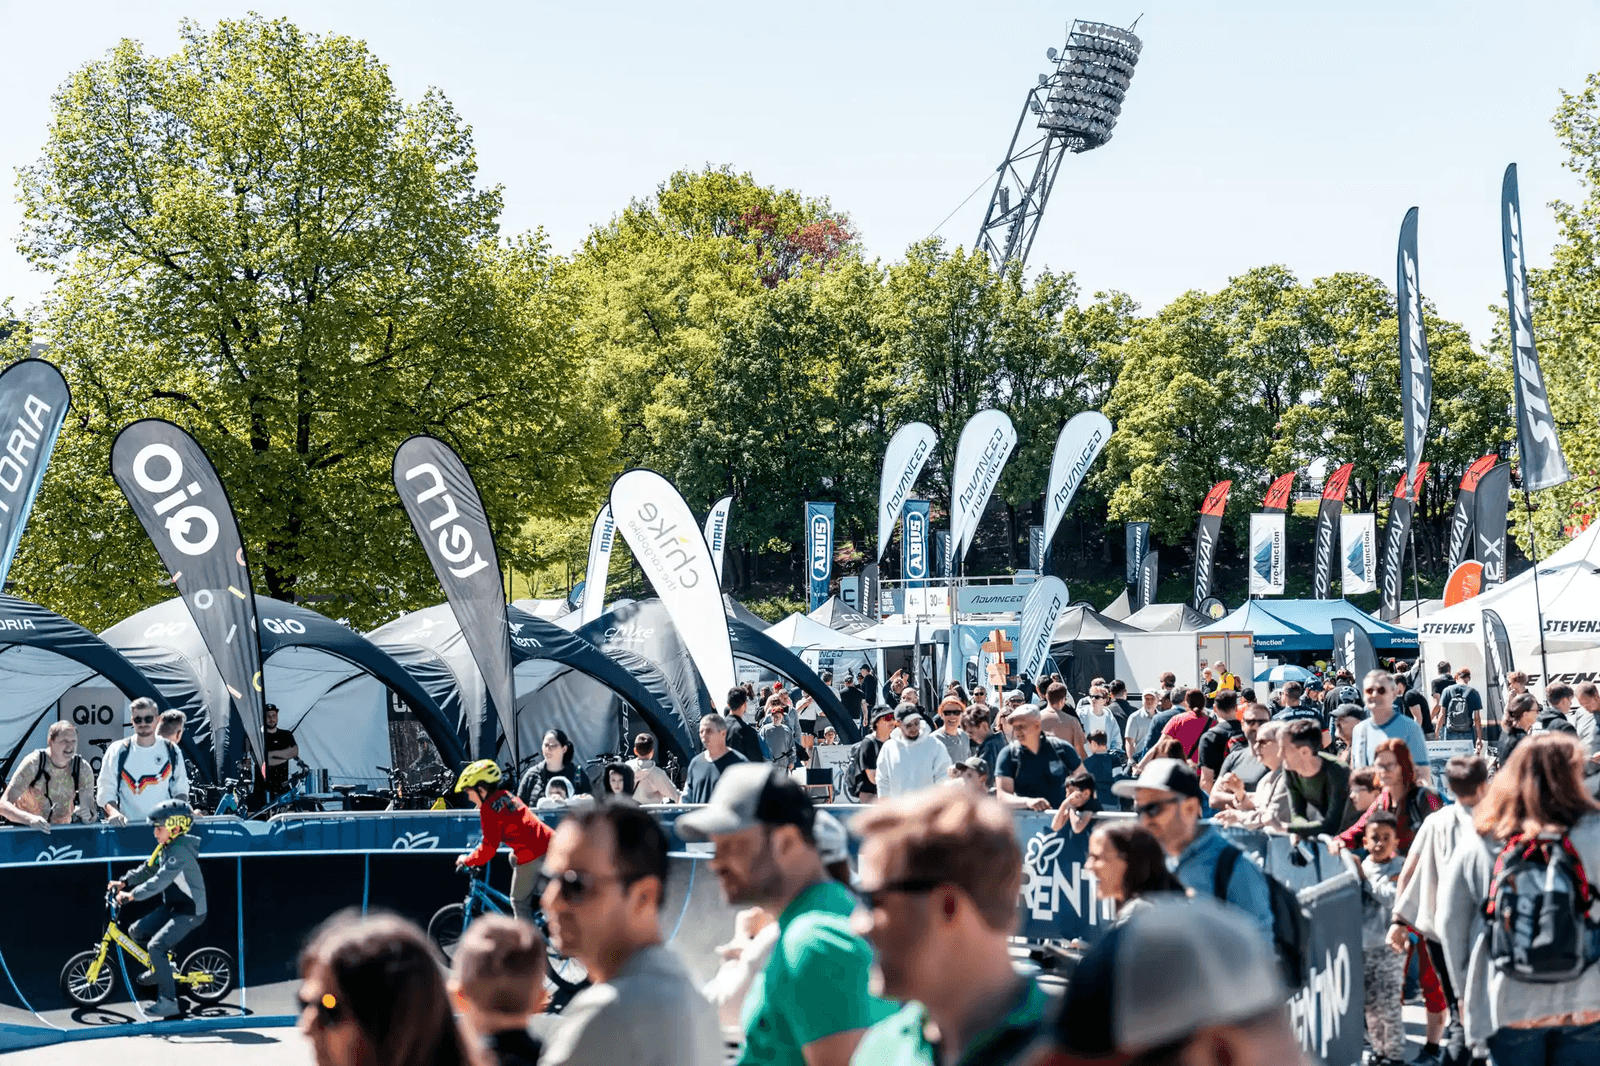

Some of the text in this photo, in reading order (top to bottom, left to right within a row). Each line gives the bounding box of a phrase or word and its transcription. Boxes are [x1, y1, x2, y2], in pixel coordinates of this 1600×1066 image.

[0, 394, 51, 512] ORIA
[960, 428, 1003, 513] ADVANCED
[1054, 429, 1103, 513] ADVANCED
[886, 439, 928, 520] ADVANCED
[713, 510, 725, 552] MAHLE
[811, 522, 827, 573] ABUS
[910, 519, 924, 570] ABUS
[1273, 531, 1282, 587] pro-function
[1364, 531, 1373, 583] pro-function
[1384, 509, 1404, 611] CONWAY
[971, 595, 1024, 604] ADVANCED
[262, 618, 306, 634] QiO
[1391, 637, 1418, 645] pro-funct
[1421, 622, 1475, 634] STEVENS
[73, 704, 114, 725] QiO
